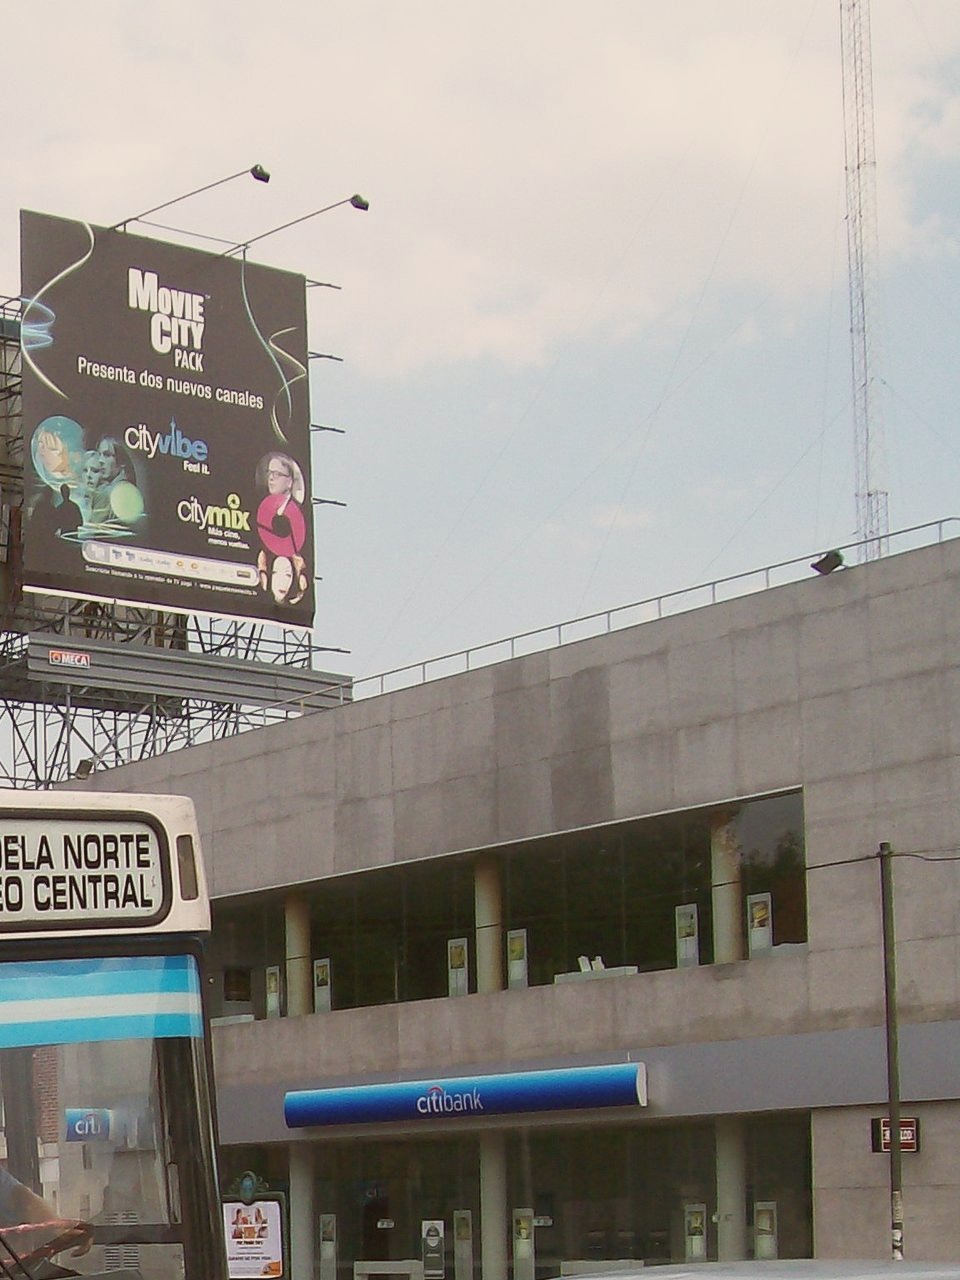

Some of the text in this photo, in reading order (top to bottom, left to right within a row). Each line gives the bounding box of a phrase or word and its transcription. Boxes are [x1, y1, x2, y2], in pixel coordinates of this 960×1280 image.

[151, 312, 204, 354] CITY
[174, 348, 204, 372] PACK
[77, 356, 264, 410] Presenta dos nuevos canales
[61, 653, 88, 666] MECA
[63, 833, 152, 870] NORTE
[33, 873, 153, 912] CENTRAL
[416, 1085, 484, 1114] citibank
